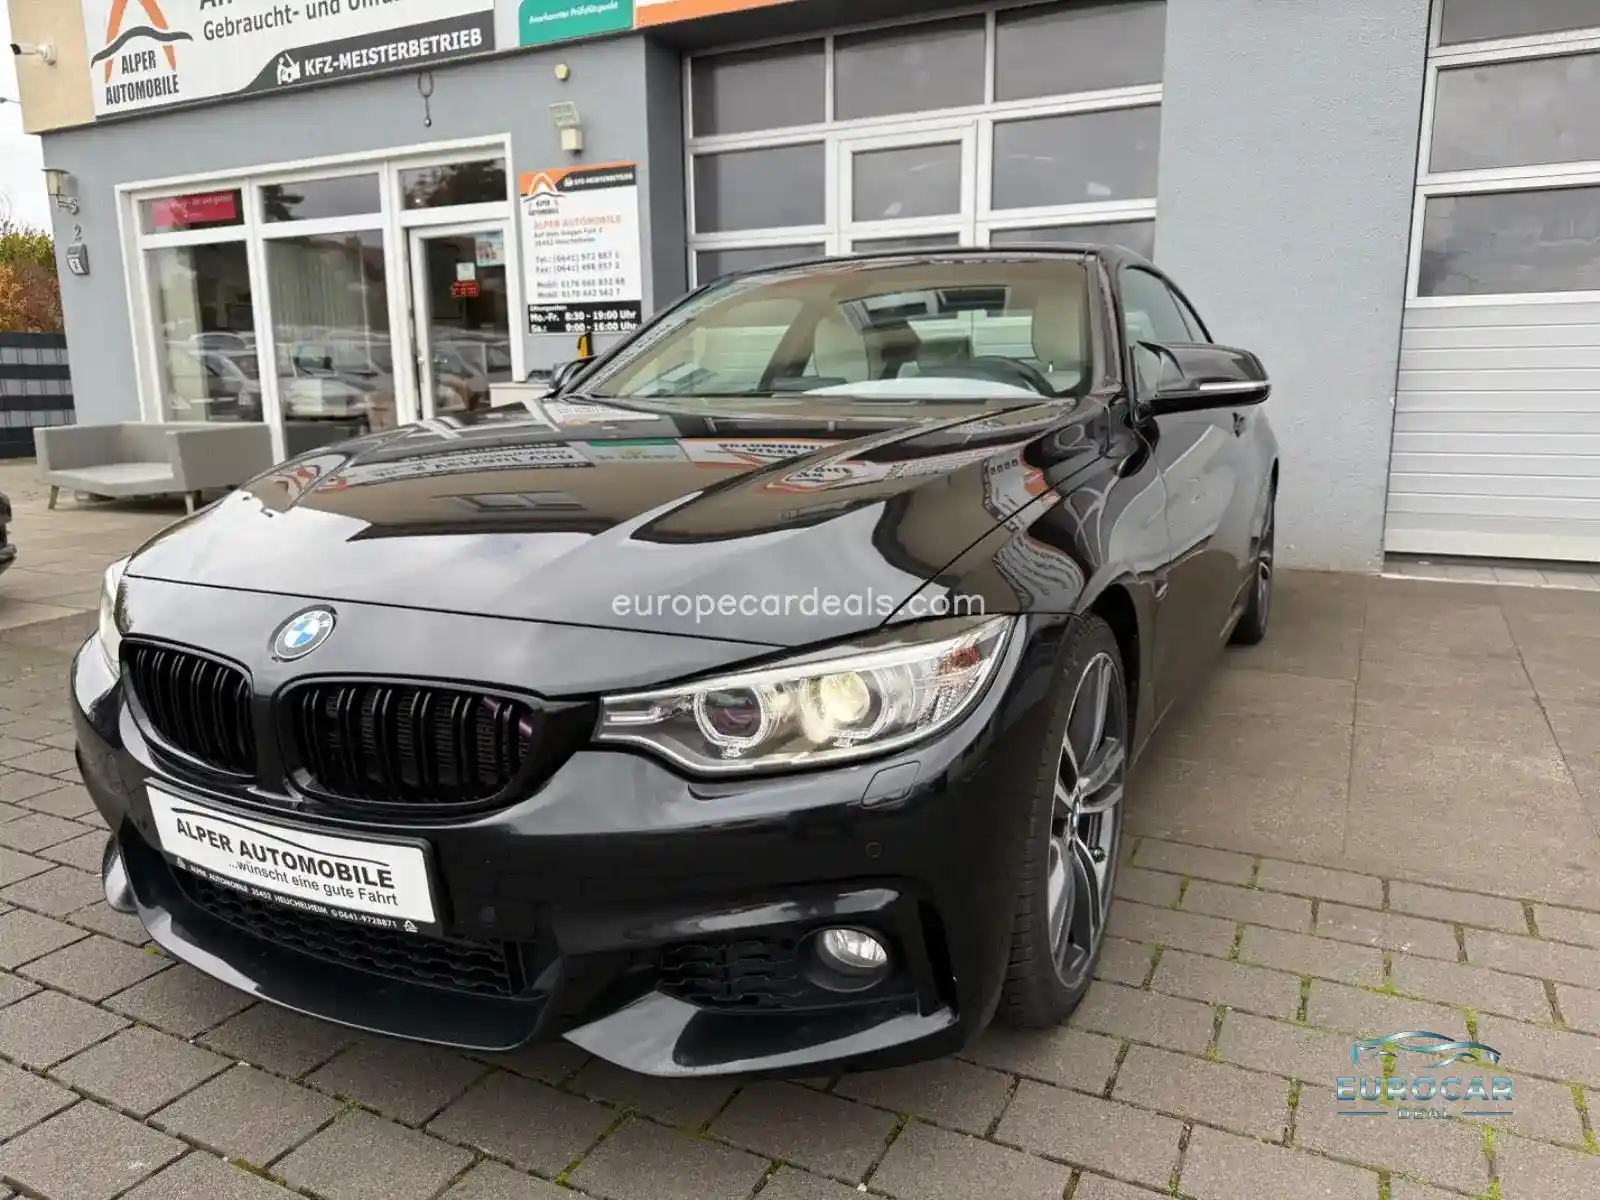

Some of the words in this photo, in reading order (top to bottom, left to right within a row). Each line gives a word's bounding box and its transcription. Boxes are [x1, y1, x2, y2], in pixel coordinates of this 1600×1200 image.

[203, 3, 300, 41] Gebraucht-
[303, 0, 341, 19] und
[121, 50, 157, 74] ALPER
[303, 26, 483, 77] KFZ-MEISTERBETRIEB
[105, 74, 180, 105] AUTOMOBILE
[74, 224, 82, 241] 2
[619, 309, 637, 319] Uhr
[620, 320, 638, 330] Uhr
[176, 818, 234, 853] ALPER
[240, 839, 394, 889] AUTOMOBILE
[292, 875, 319, 891] eine
[323, 883, 354, 898] gute
[358, 887, 399, 906] Fahrt
[275, 895, 328, 914] HEUCHELHEIM
